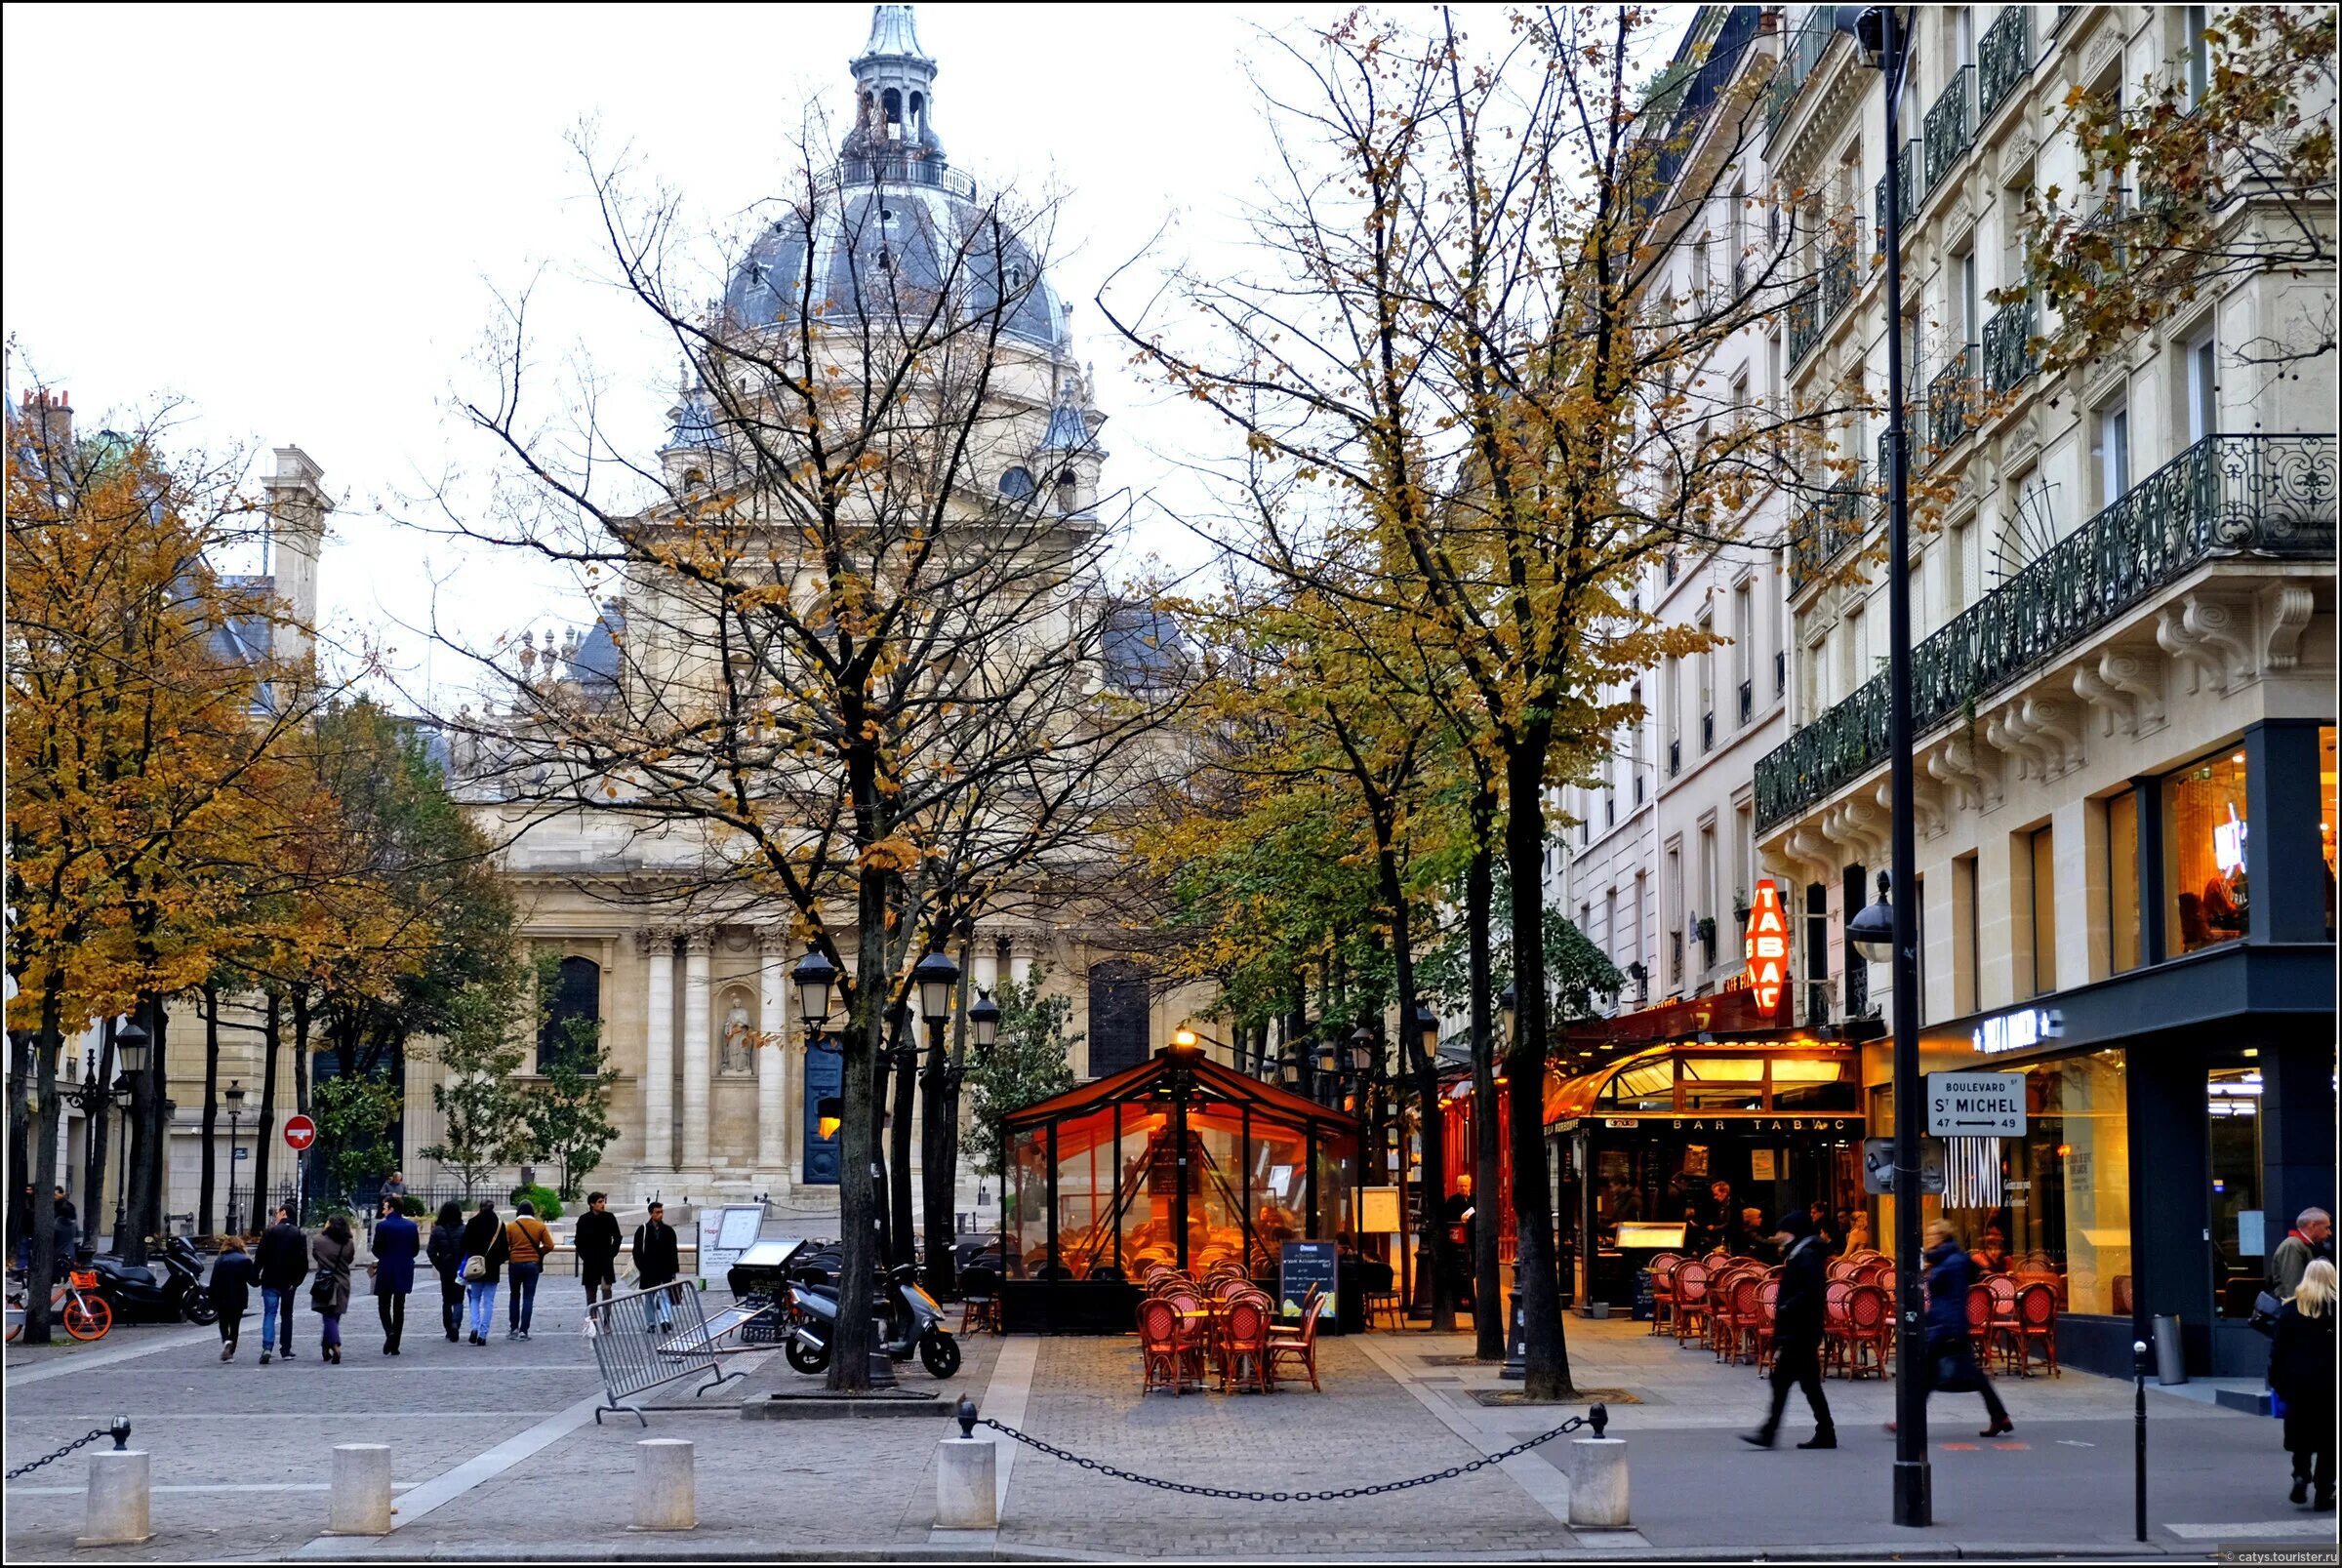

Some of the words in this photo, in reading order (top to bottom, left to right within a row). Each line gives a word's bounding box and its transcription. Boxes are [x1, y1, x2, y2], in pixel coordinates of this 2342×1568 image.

[1757, 887, 1785, 1008] TABAC
[1946, 1082, 2005, 1093] BOULEVARD
[1956, 1099, 2018, 1112] MICHEL
[1673, 1120, 1724, 1130] BAR
[1754, 1119, 1844, 1130] TABAC
[1936, 1119, 1950, 1128] 47
[2001, 1118, 2016, 1128] 49
[1941, 1137, 2001, 1209] AUTUMN
